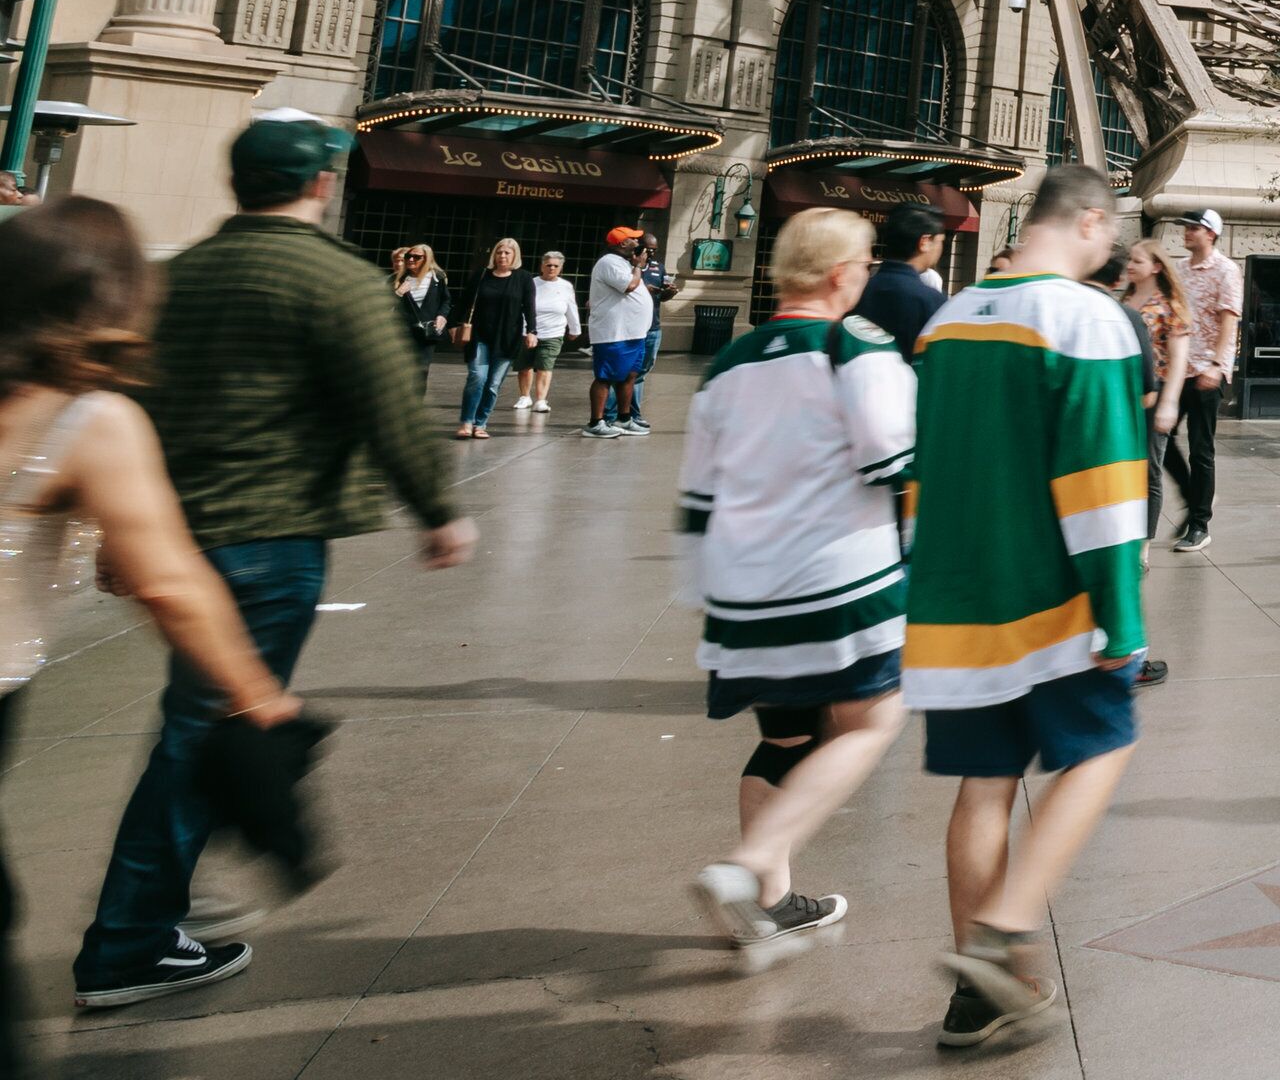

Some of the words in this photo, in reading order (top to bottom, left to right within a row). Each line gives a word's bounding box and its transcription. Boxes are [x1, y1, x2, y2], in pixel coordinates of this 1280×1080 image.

[439, 145, 482, 168] Le
[501, 151, 602, 177] Casino
[495, 181, 565, 199] Entrance
[820, 181, 850, 199] Le
[859, 185, 931, 206] Casino
